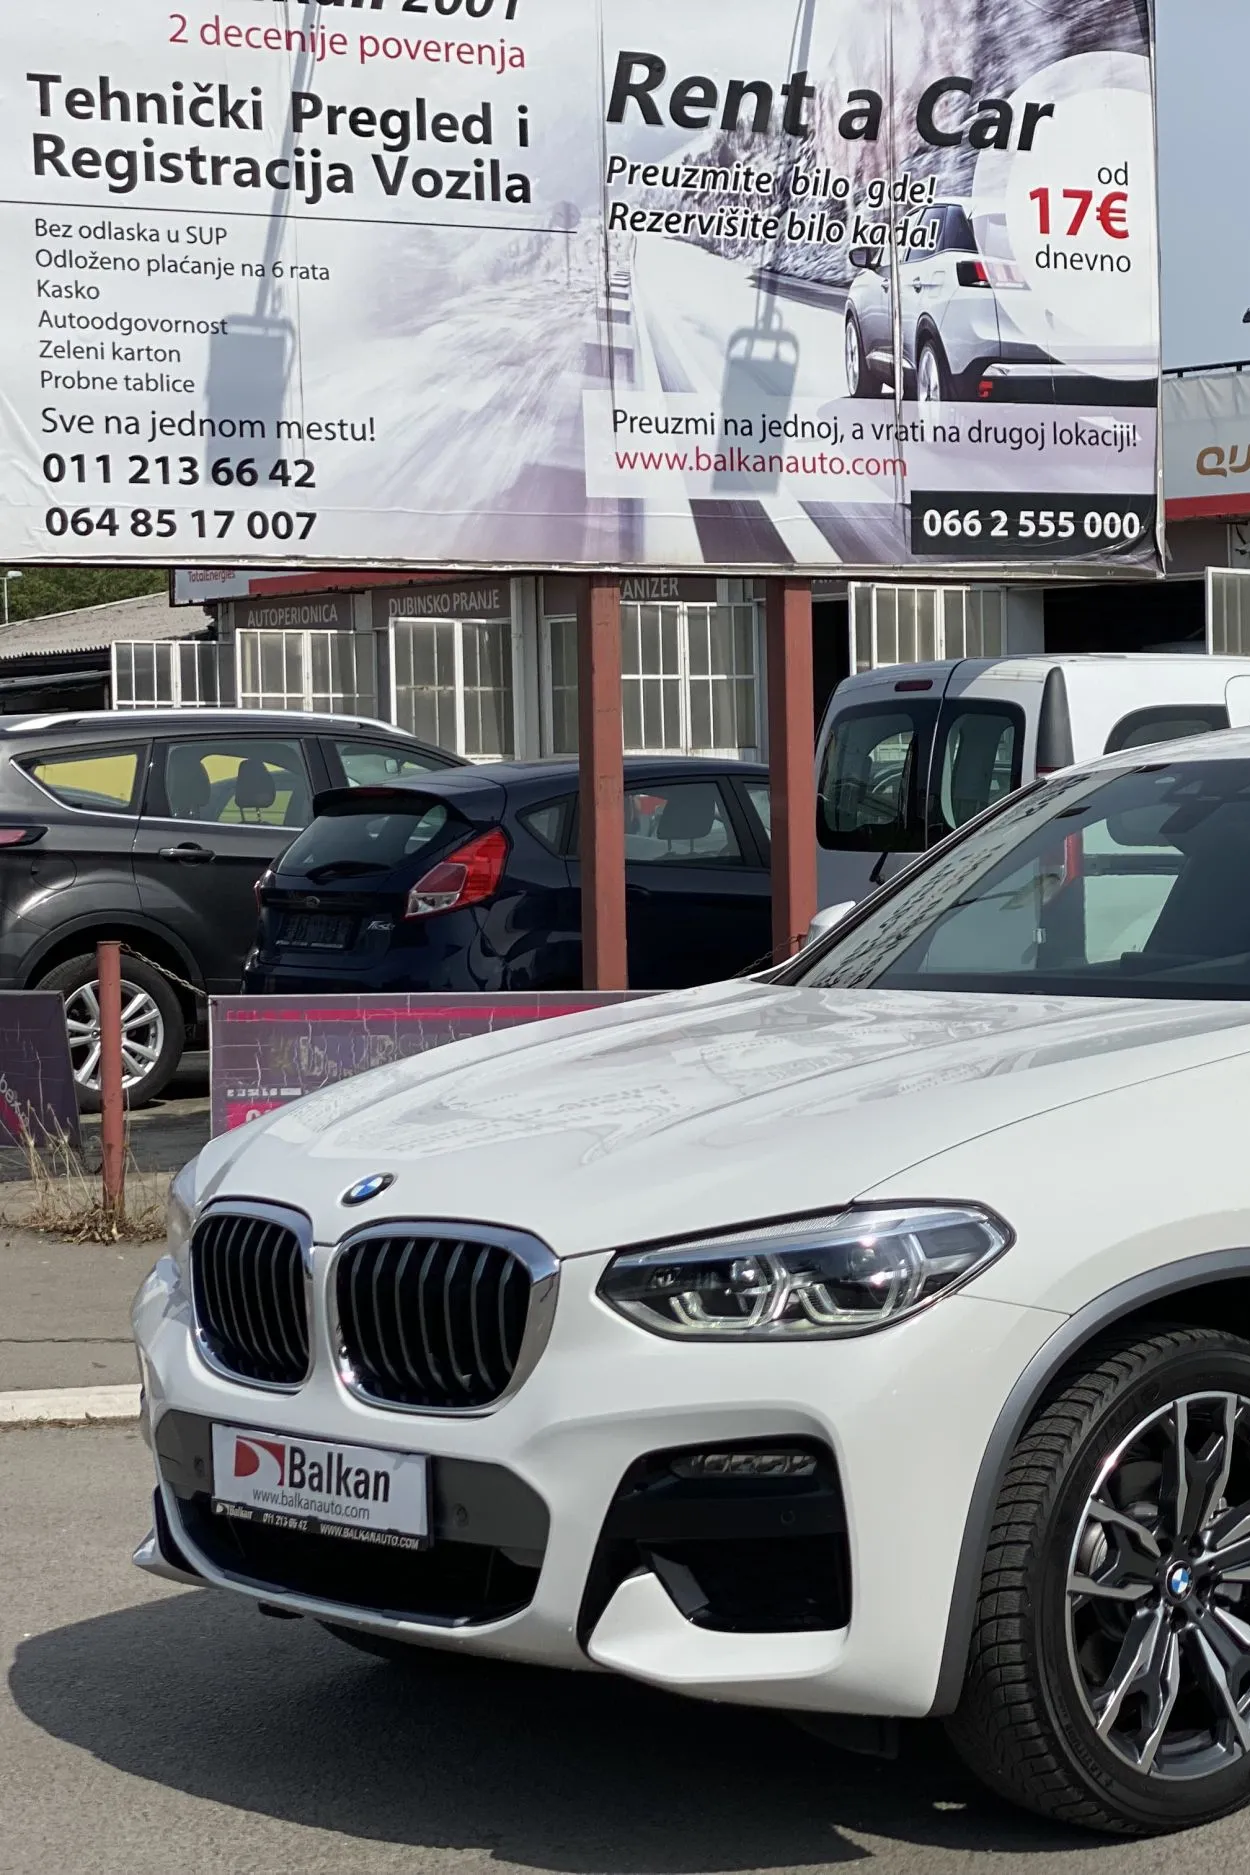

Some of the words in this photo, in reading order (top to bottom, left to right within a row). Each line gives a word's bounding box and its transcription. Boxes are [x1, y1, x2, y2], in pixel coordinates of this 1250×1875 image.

[169, 14, 189, 44] 2
[200, 15, 348, 63] decenije
[359, 30, 526, 75] poverenja
[26, 72, 264, 131] Tehnički
[291, 92, 493, 153] Pregled
[517, 105, 530, 147] i
[605, 50, 816, 137] Rent
[836, 88, 883, 142] a
[915, 75, 1055, 152] Car
[31, 132, 355, 205] Registracija
[371, 154, 532, 204] Vozila
[605, 156, 774, 194] Preuzmite
[790, 166, 848, 199] bilo
[867, 176, 937, 208] gde!
[1097, 161, 1129, 186] od
[608, 206, 780, 240] Rezervišite
[786, 211, 845, 243] bilo
[852, 217, 941, 250] kada!
[1029, 186, 1130, 239] 17€
[35, 218, 73, 239] Bez
[78, 221, 160, 243] odlaska
[167, 228, 180, 243] u
[186, 226, 228, 246] SUP
[35, 248, 141, 272] Odloženo
[147, 252, 235, 281] plaćanje
[240, 262, 266, 278] na
[272, 260, 284, 279] 6
[289, 262, 330, 281] rata
[1035, 247, 1131, 273] dnevno
[36, 279, 100, 301] Kasko
[38, 310, 229, 342] Autoodgovornost
[39, 340, 105, 361] Zeleni
[111, 342, 181, 364] karton
[40, 371, 118, 392] Probne
[123, 373, 195, 394] tablice
[41, 407, 94, 435] Sve
[104, 415, 140, 436] na
[148, 411, 266, 443] jednom
[276, 416, 376, 443] mestu!
[612, 409, 715, 437] Preuzmi
[723, 418, 754, 438] na
[760, 414, 846, 445] jednoj,
[852, 422, 865, 440] a
[871, 420, 925, 443] vrati
[932, 424, 961, 444] na
[967, 421, 1046, 452] drugoj
[1052, 422, 1138, 453] lokaciji!
[42, 453, 113, 484] 011
[128, 454, 200, 486] 213
[210, 456, 259, 487] 66
[268, 458, 316, 488] 42
[616, 446, 908, 478] www.balkanauto.com
[45, 507, 120, 537] 064
[130, 508, 177, 538] 85
[190, 509, 235, 538] 17
[246, 510, 318, 540] 007
[923, 508, 982, 537] 066
[990, 510, 1010, 537] 2
[1018, 510, 1075, 538] 555
[1083, 511, 1140, 539] 000
[247, 603, 339, 627] AUTOPERIONICA
[389, 593, 450, 616] DUBINSKO
[452, 589, 500, 612] PRANJE
[288, 1446, 390, 1503] Balkan
[253, 1487, 370, 1521] www.balkanauto.com
[320, 1523, 419, 1550] WWW.BALKANAUTO.COM
